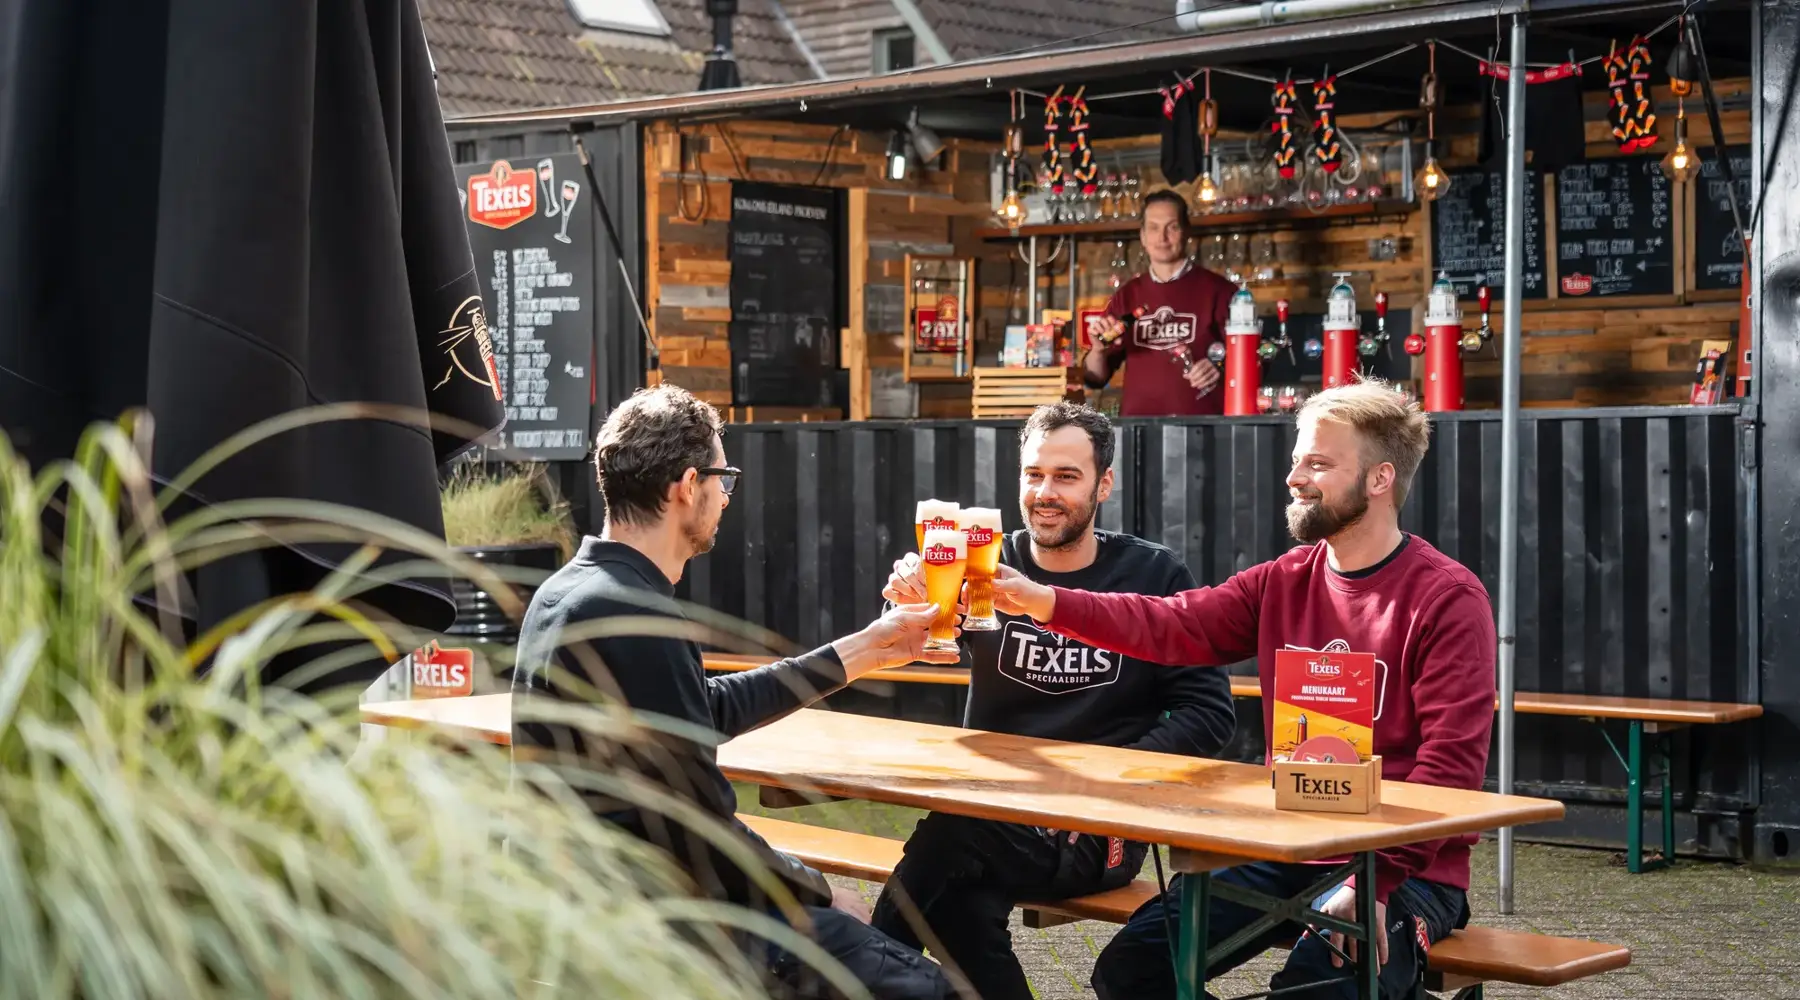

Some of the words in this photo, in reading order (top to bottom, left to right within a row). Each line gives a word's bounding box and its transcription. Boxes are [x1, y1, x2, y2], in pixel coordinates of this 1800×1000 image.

[472, 181, 532, 212] TEXELS
[1139, 320, 1190, 339] TEXELS
[926, 548, 954, 561] TEXELS
[1012, 631, 1112, 674] TEXELS
[413, 662, 466, 687] EXELS
[1026, 672, 1091, 684] SPECIAALBIER
[1308, 661, 1341, 675] TEXELS
[1301, 685, 1346, 696] MENUKAART
[1290, 773, 1352, 795] TEXELS
[1111, 836, 1120, 864] XELS
